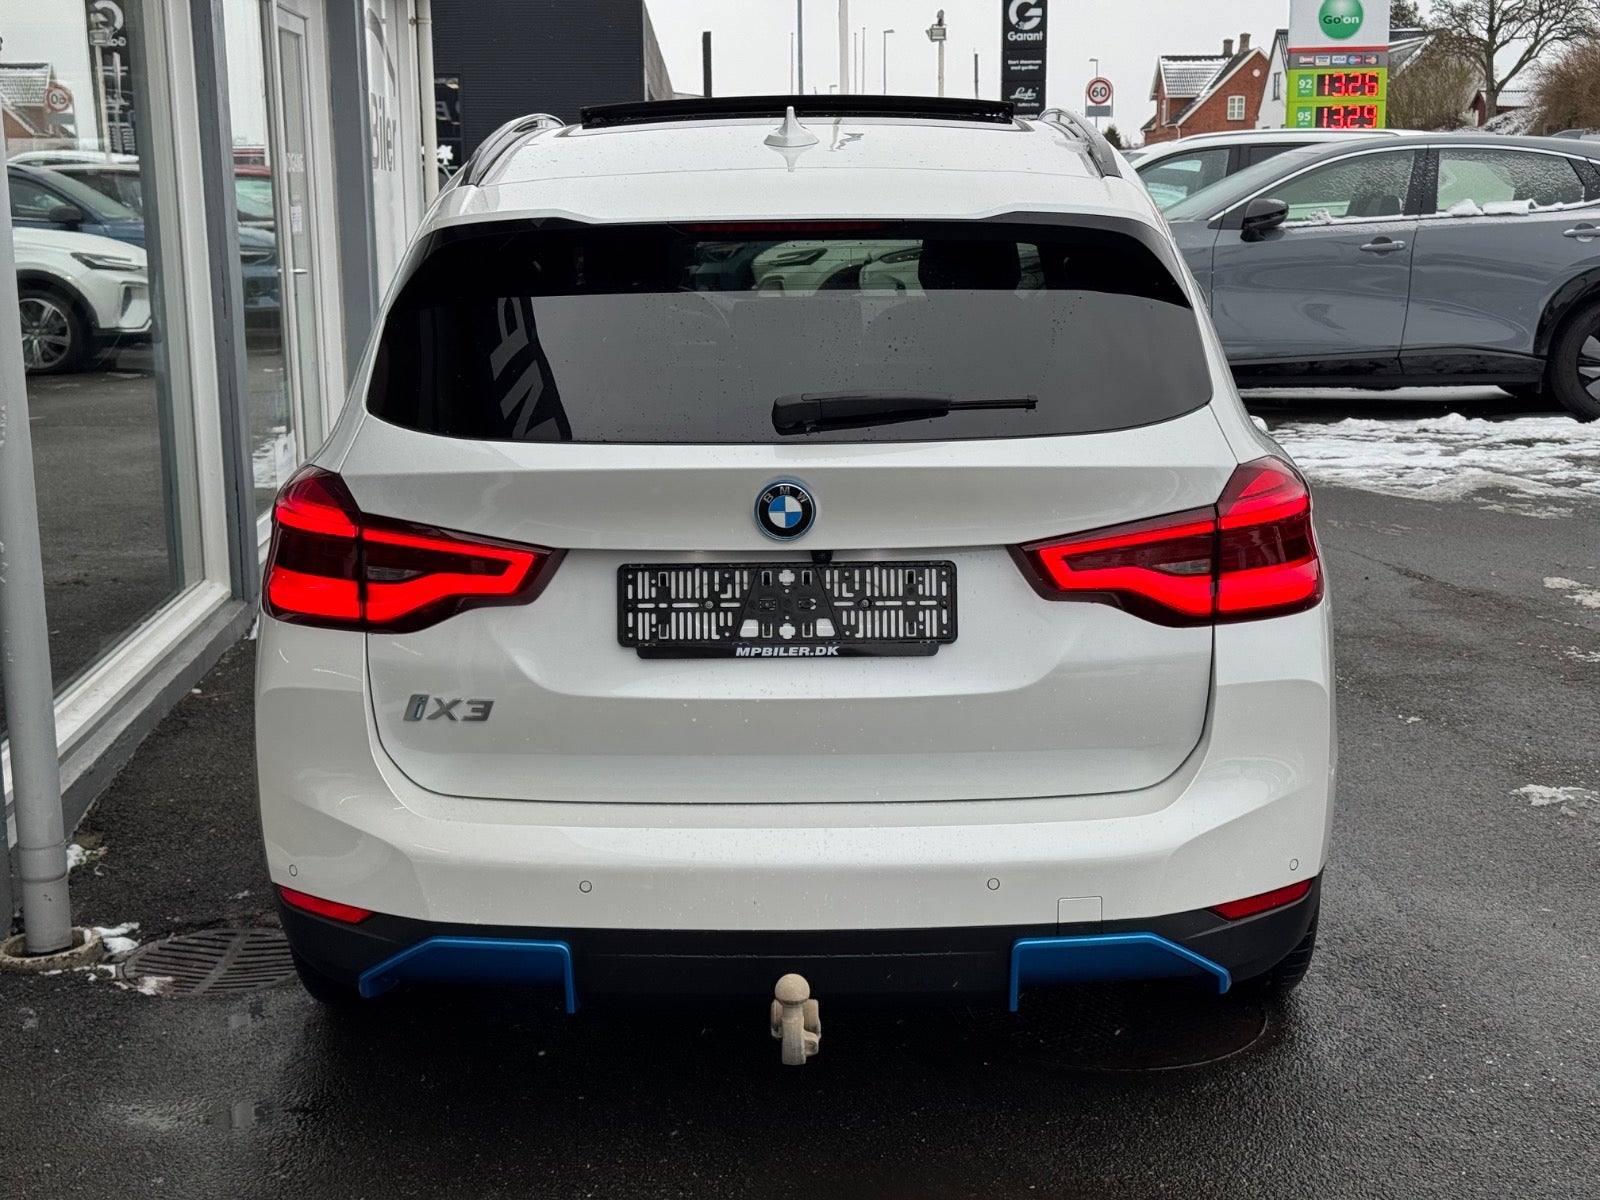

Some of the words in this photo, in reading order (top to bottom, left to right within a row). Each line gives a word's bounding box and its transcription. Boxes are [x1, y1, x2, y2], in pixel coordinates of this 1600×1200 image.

[1007, 31, 1043, 41] Garant
[1298, 79, 1313, 89] 92
[1324, 72, 1378, 97] 13.26
[1092, 87, 1107, 98] 60
[1297, 111, 1312, 122] 95
[370, 92, 397, 172] Biler
[763, 485, 809, 504] BMW
[735, 645, 840, 657] MPBILER.DK
[403, 694, 494, 721] iX3
